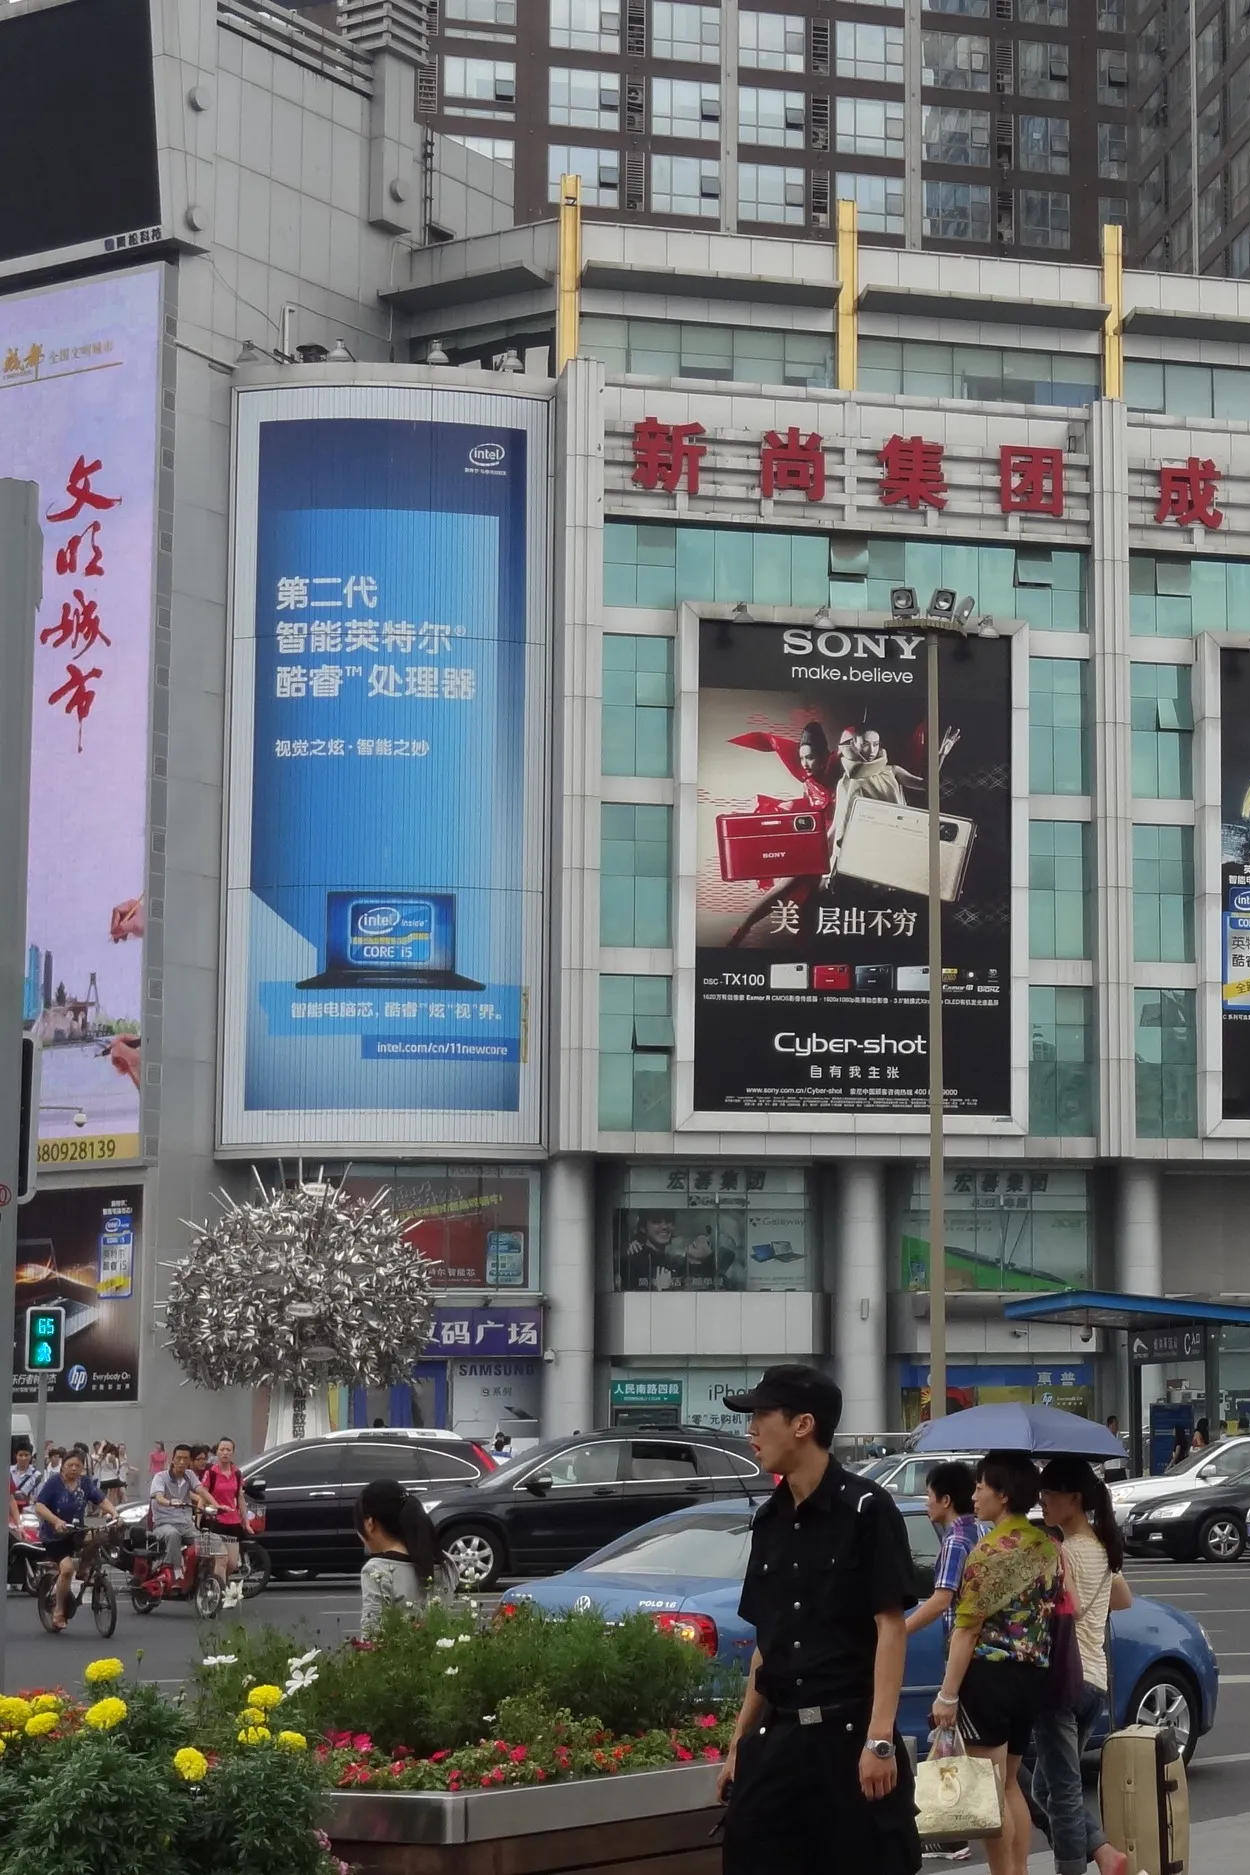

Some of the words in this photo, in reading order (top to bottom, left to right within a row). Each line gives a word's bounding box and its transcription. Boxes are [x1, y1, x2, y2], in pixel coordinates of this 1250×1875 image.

[631, 416, 1065, 517] 新尚集团
[276, 575, 378, 610] 第二代
[783, 630, 924, 660] SONY
[791, 663, 914, 684] make.believe
[762, 851, 786, 859] SONY
[770, 899, 800, 935] 美
[816, 906, 918, 937] 层出不穷
[363, 946, 394, 958] CORE
[401, 946, 412, 958] i5
[377, 1041, 508, 1056] intel.com/cn/11newcore
[773, 1032, 927, 1056] Cyber-shot
[810, 1064, 900, 1079] 自有我主张
[746, 1087, 842, 1096] www.sony.com.cn/Cyber-shot
[914, 1088, 926, 1096] 400
[459, 1364, 535, 1377] SAMSUNG
[70, 1365, 88, 1392] hp
[92, 1372, 121, 1382] Everybody
[121, 1371, 131, 1380] On
[614, 1383, 680, 1395] 人民南路四段
[1042, 1392, 1053, 1407] hp
[639, 1600, 663, 1608] POLO
